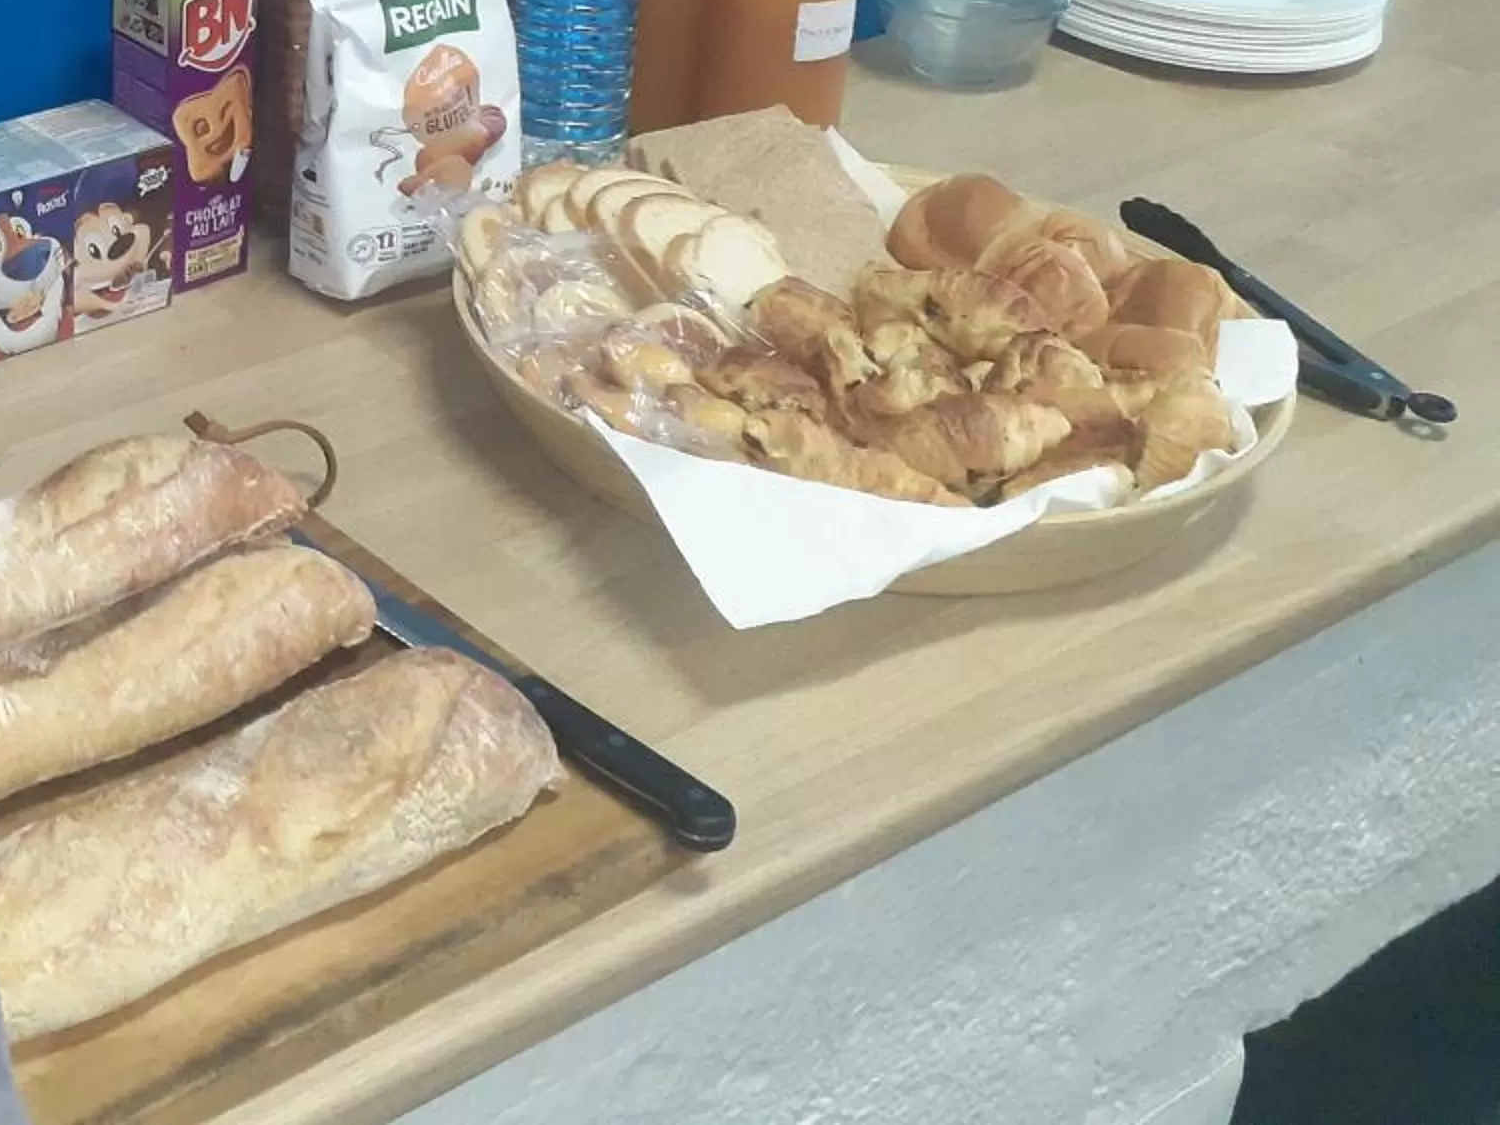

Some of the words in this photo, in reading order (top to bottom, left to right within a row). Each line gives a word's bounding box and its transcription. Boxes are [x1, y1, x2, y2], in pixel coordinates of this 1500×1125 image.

[185, 194, 242, 225] CHOCOLAT
[191, 220, 209, 238] AU
[213, 209, 237, 232] LAIT
